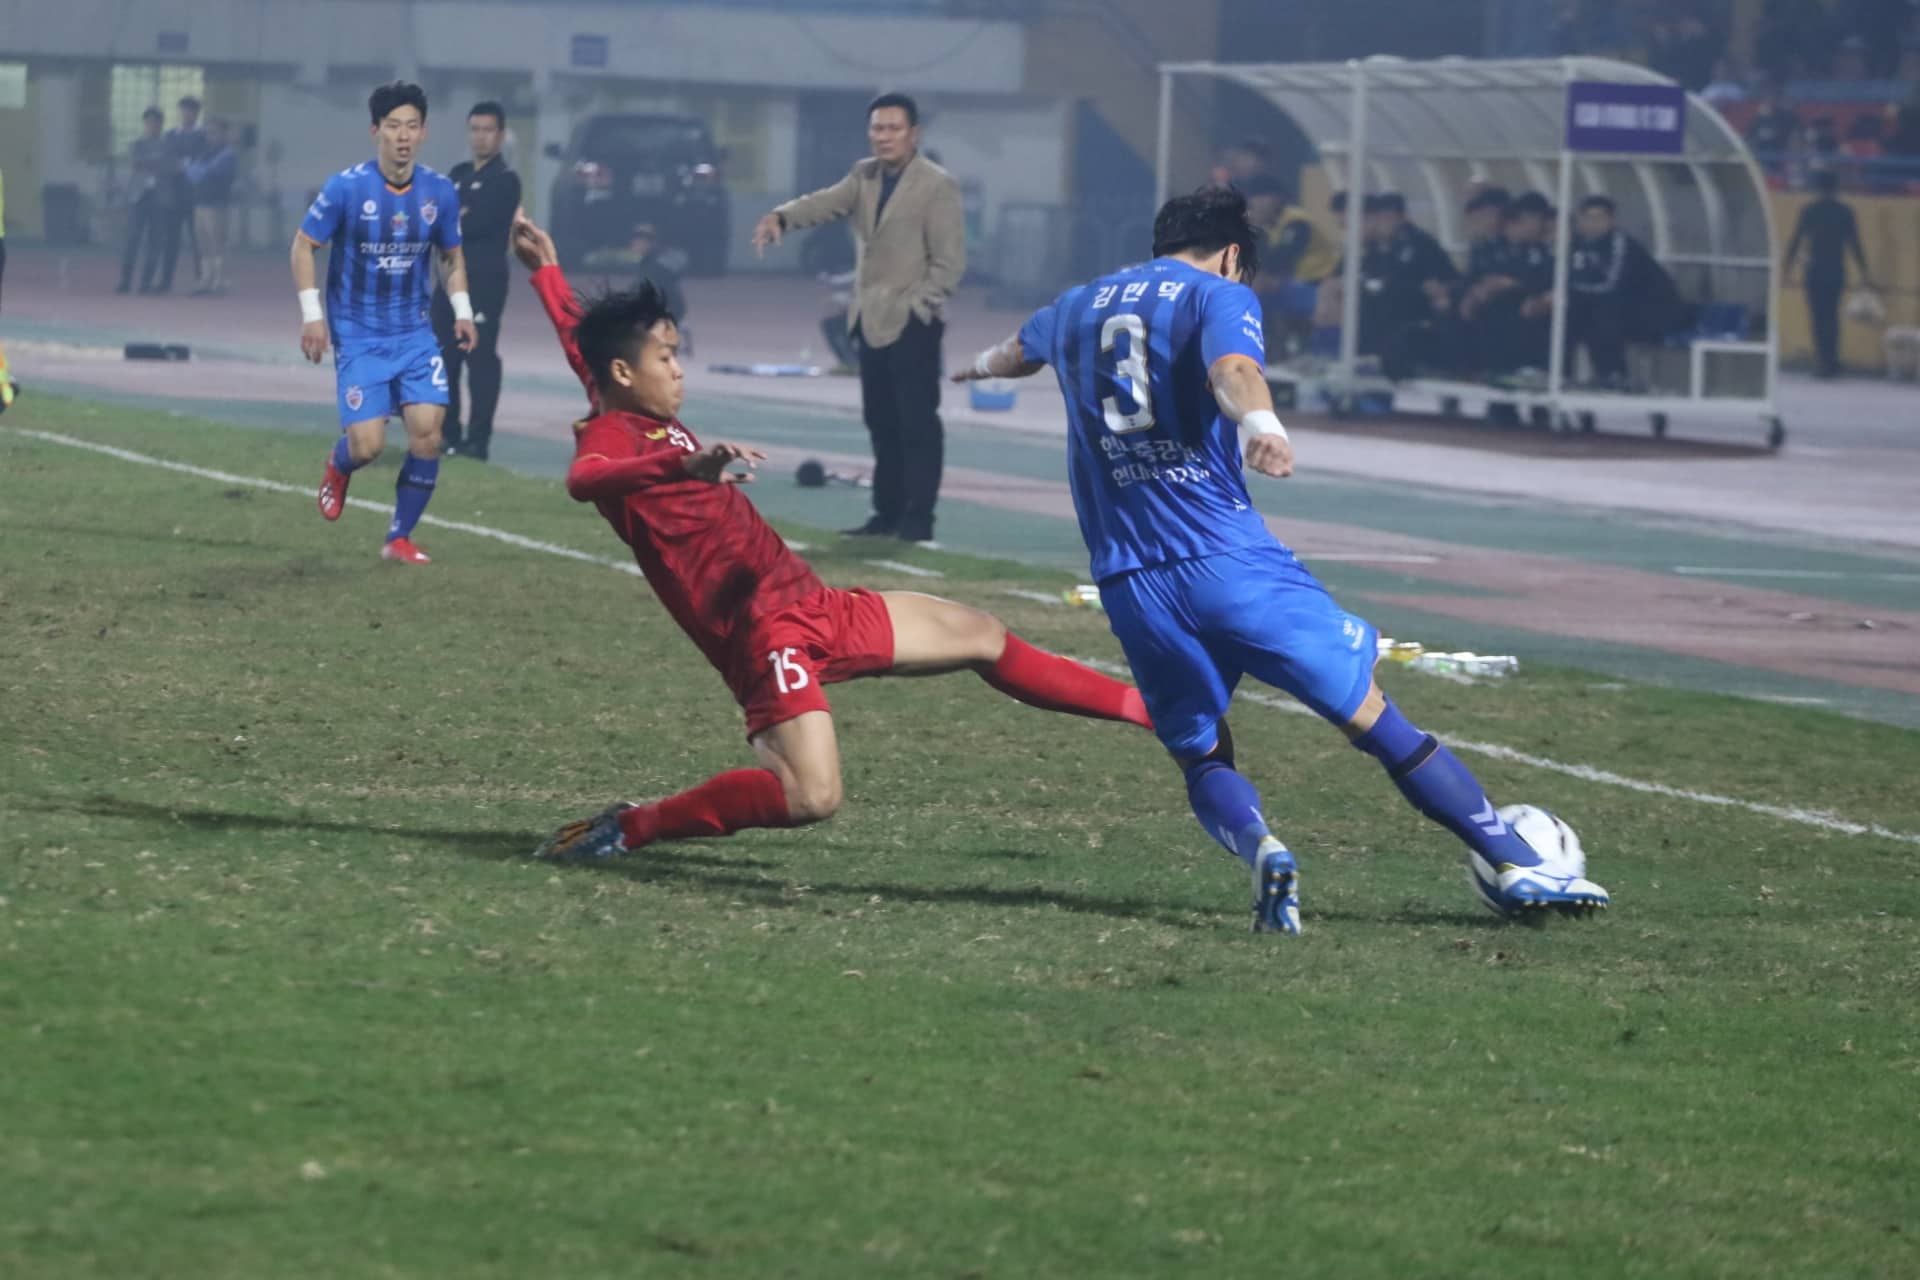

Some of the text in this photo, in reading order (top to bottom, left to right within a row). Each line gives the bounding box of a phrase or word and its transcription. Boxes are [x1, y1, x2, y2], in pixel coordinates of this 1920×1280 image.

[431, 356, 447, 386] 2
[1101, 313, 1155, 435] 3
[768, 647, 809, 694] 15
